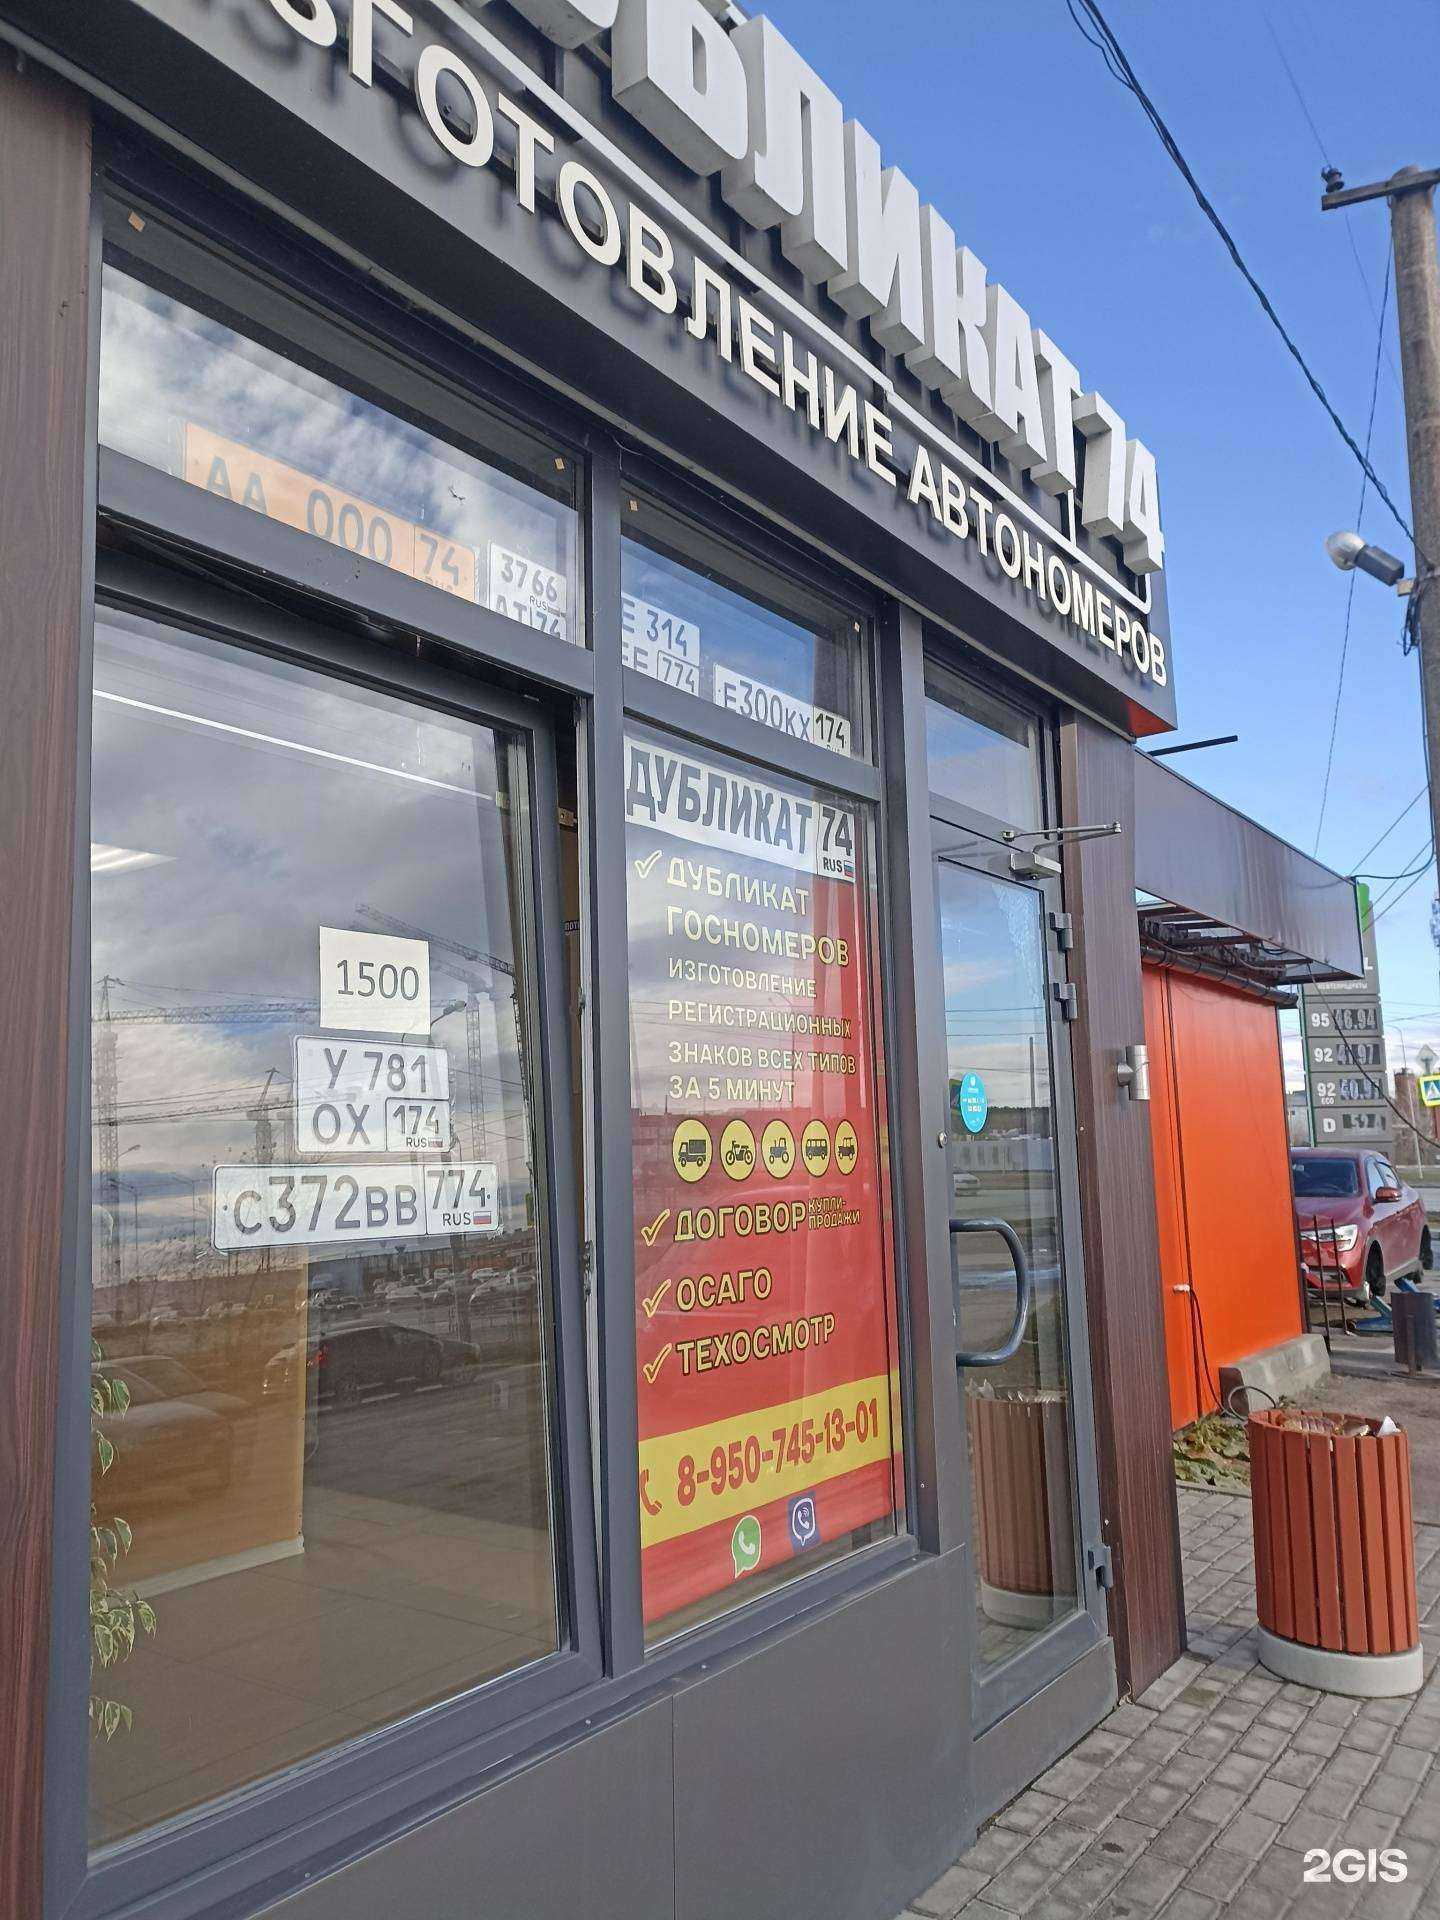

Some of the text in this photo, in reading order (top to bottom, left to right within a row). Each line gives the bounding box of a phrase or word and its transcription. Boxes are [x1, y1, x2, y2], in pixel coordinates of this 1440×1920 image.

[270, 0, 1167, 687] ГОТОВЛЕНИЕ АВТОНОМЕРОВ
[1074, 391, 1165, 574] 74
[416, 534, 459, 586] 74
[501, 553, 558, 602] 3766
[646, 609, 687, 657] 314
[662, 656, 695, 693] 774
[815, 713, 845, 749] 174
[626, 745, 853, 856] ДУБЛИКАТ 74
[822, 855, 843, 873] RUS
[666, 856, 810, 916] ДУБЛИКАТ
[666, 905, 850, 967] ГОСНОМЕРОВ
[336, 959, 420, 1001] 1500
[668, 957, 817, 998] ИЗГОТОВЛЕНИЕ
[668, 1000, 851, 1039] РЕГИСТРАЦИОННЫХ
[1311, 1012, 1330, 1028] 95
[364, 1051, 427, 1093] 781
[668, 1041, 856, 1075] ЗНАКОВ ВСЕХ ТИПОВ
[1314, 1047, 1333, 1063] 92
[669, 1075, 795, 1102] ЗА 5 МИНУТ
[1317, 1082, 1337, 1097] 92
[392, 1104, 440, 1136] 174
[1323, 1118, 1336, 1132] D
[405, 1136, 427, 1149] RUS
[427, 1169, 487, 1210] 774
[442, 1211, 472, 1227] RUS
[673, 1200, 807, 1243] ДОГОВОР
[808, 1209, 861, 1231] ПРОДАЖИ
[675, 1267, 773, 1312] ОСАГО
[676, 1313, 836, 1376] ТЕХОСМОТР
[677, 1398, 879, 1507] 8-950-745-13-01
